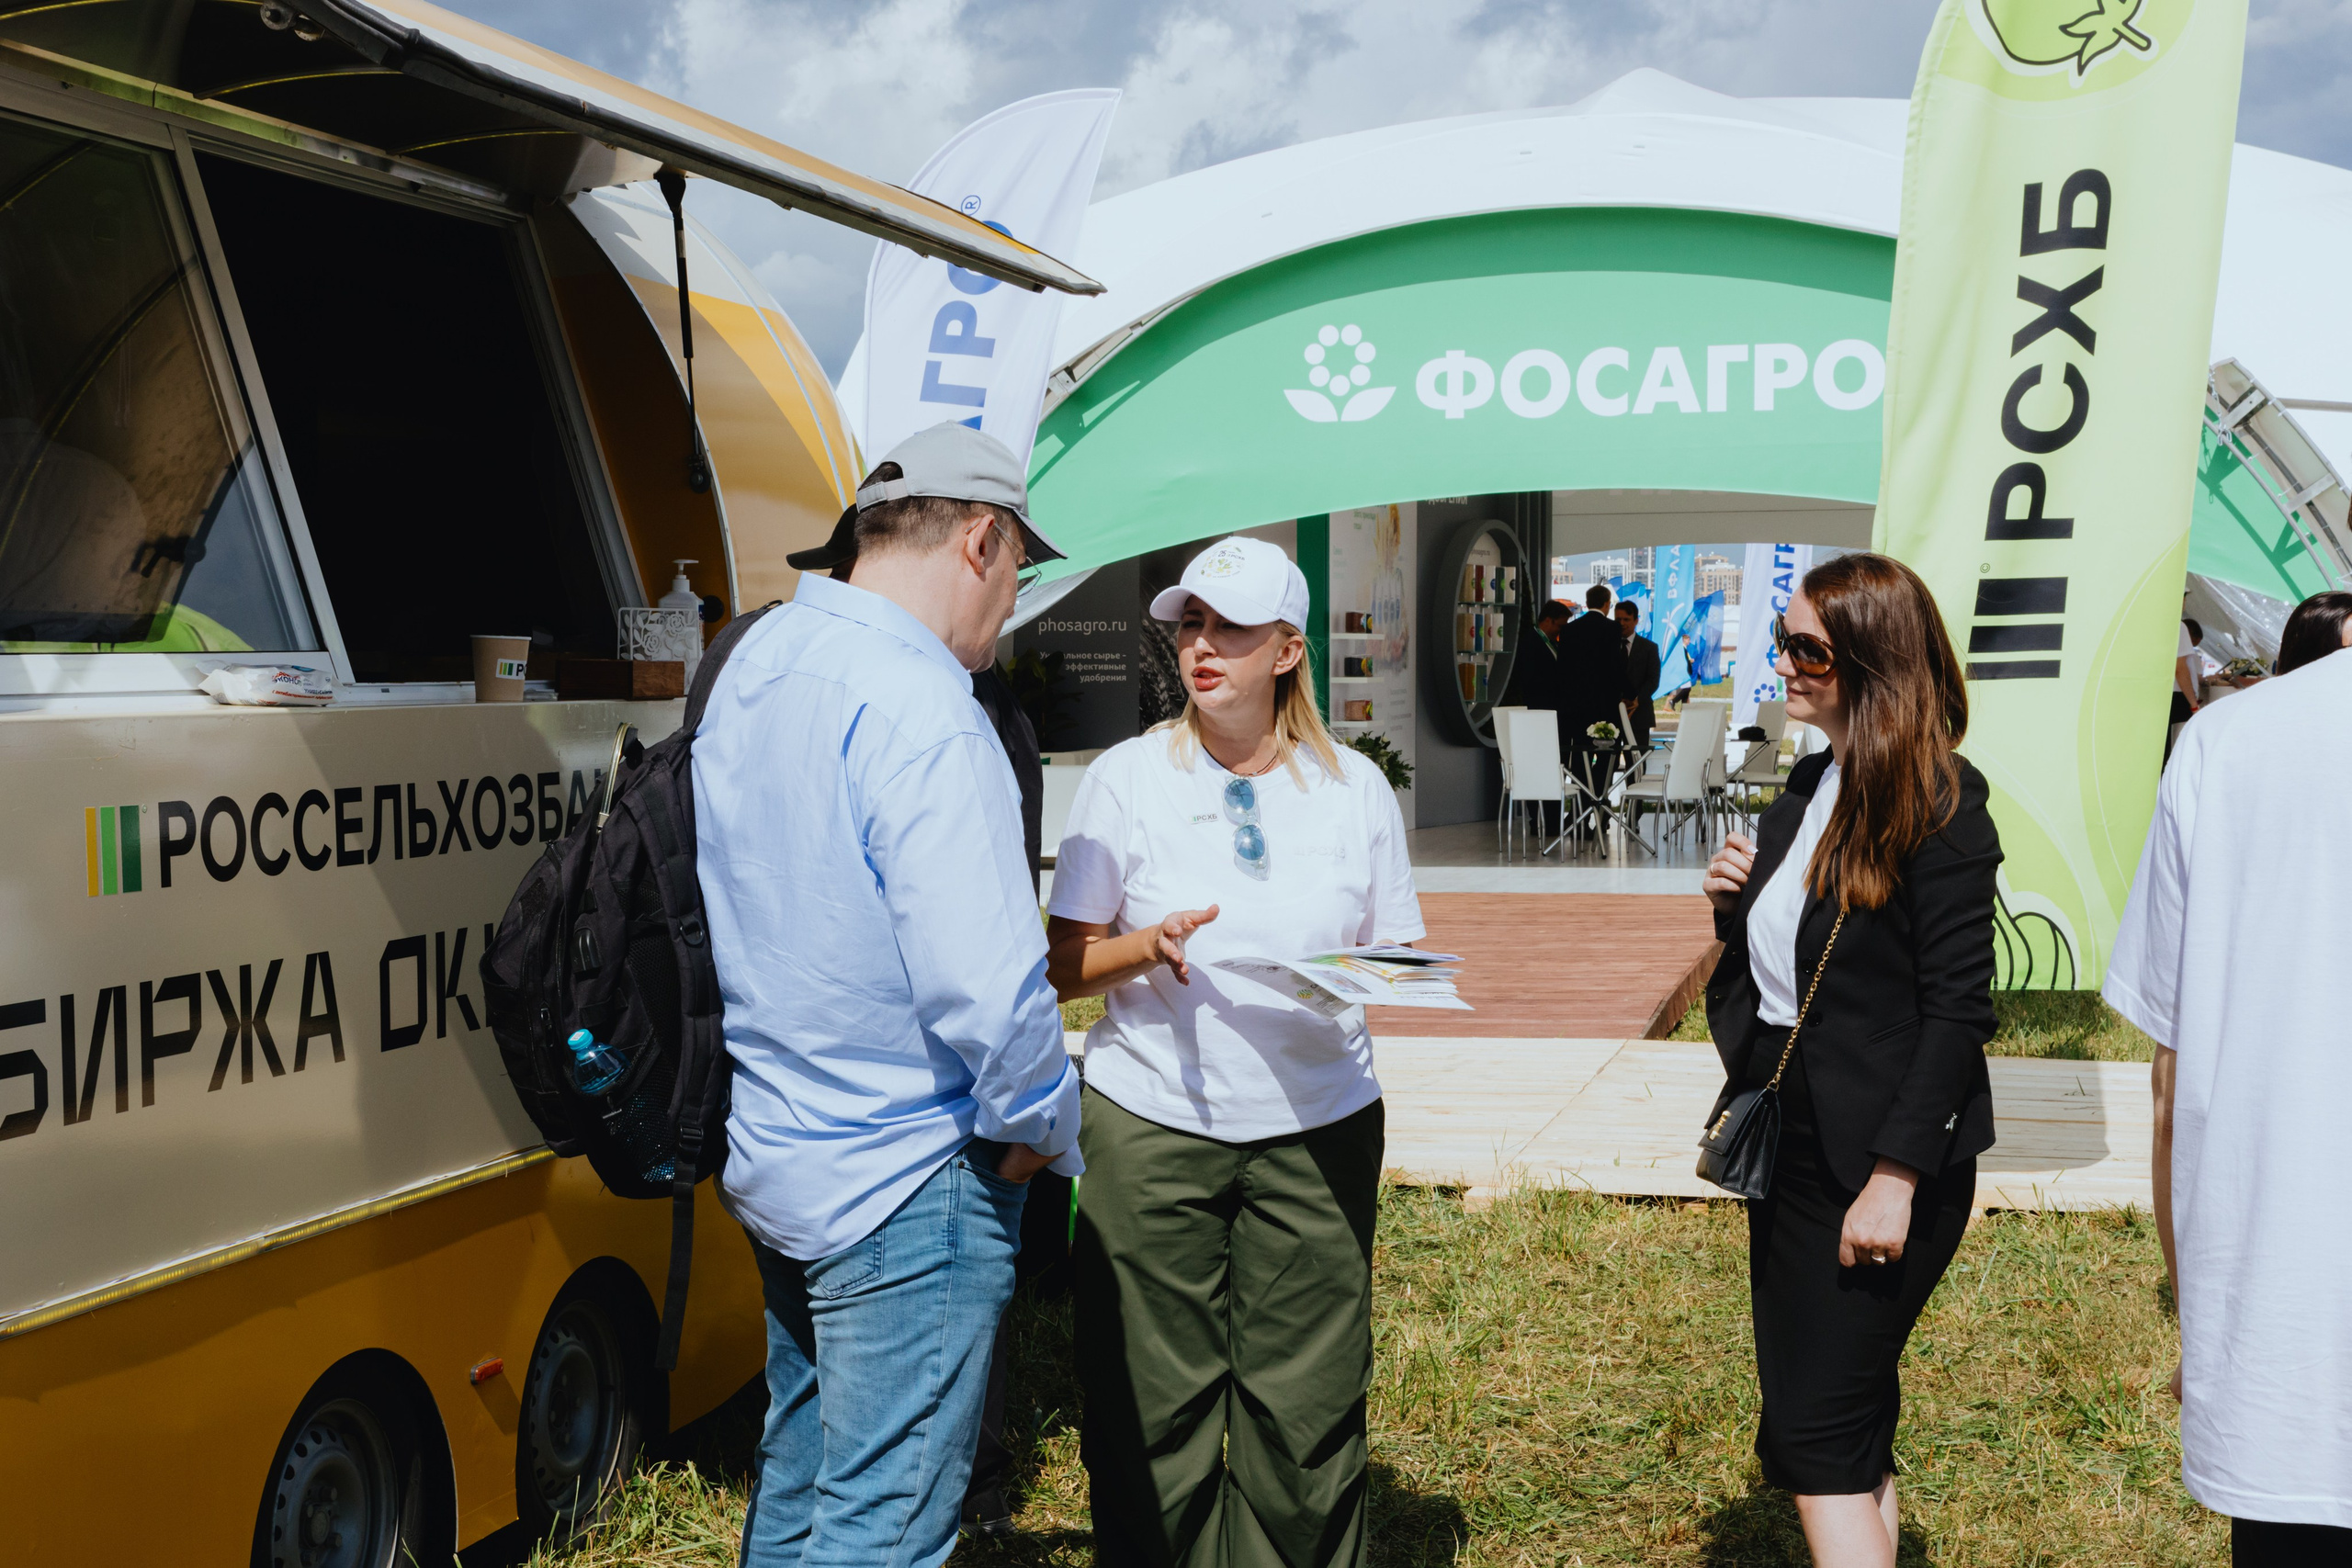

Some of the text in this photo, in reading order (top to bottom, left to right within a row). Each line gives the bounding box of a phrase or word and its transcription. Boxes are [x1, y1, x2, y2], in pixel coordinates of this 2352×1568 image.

[1984, 168, 2111, 541] РСХБ
[1415, 339, 1886, 420] ФОСАГРО
[1038, 617, 1127, 635] phosagro.ru
[1093, 652, 1121, 660] сырье
[1065, 663, 1126, 671] эффективные
[1080, 673, 1126, 682] удобрения
[1196, 813, 1217, 821] РСХБ
[159, 769, 603, 888] РОССЕЛЬХОЗБА
[0, 920, 502, 1142] БИРЖА ОК
